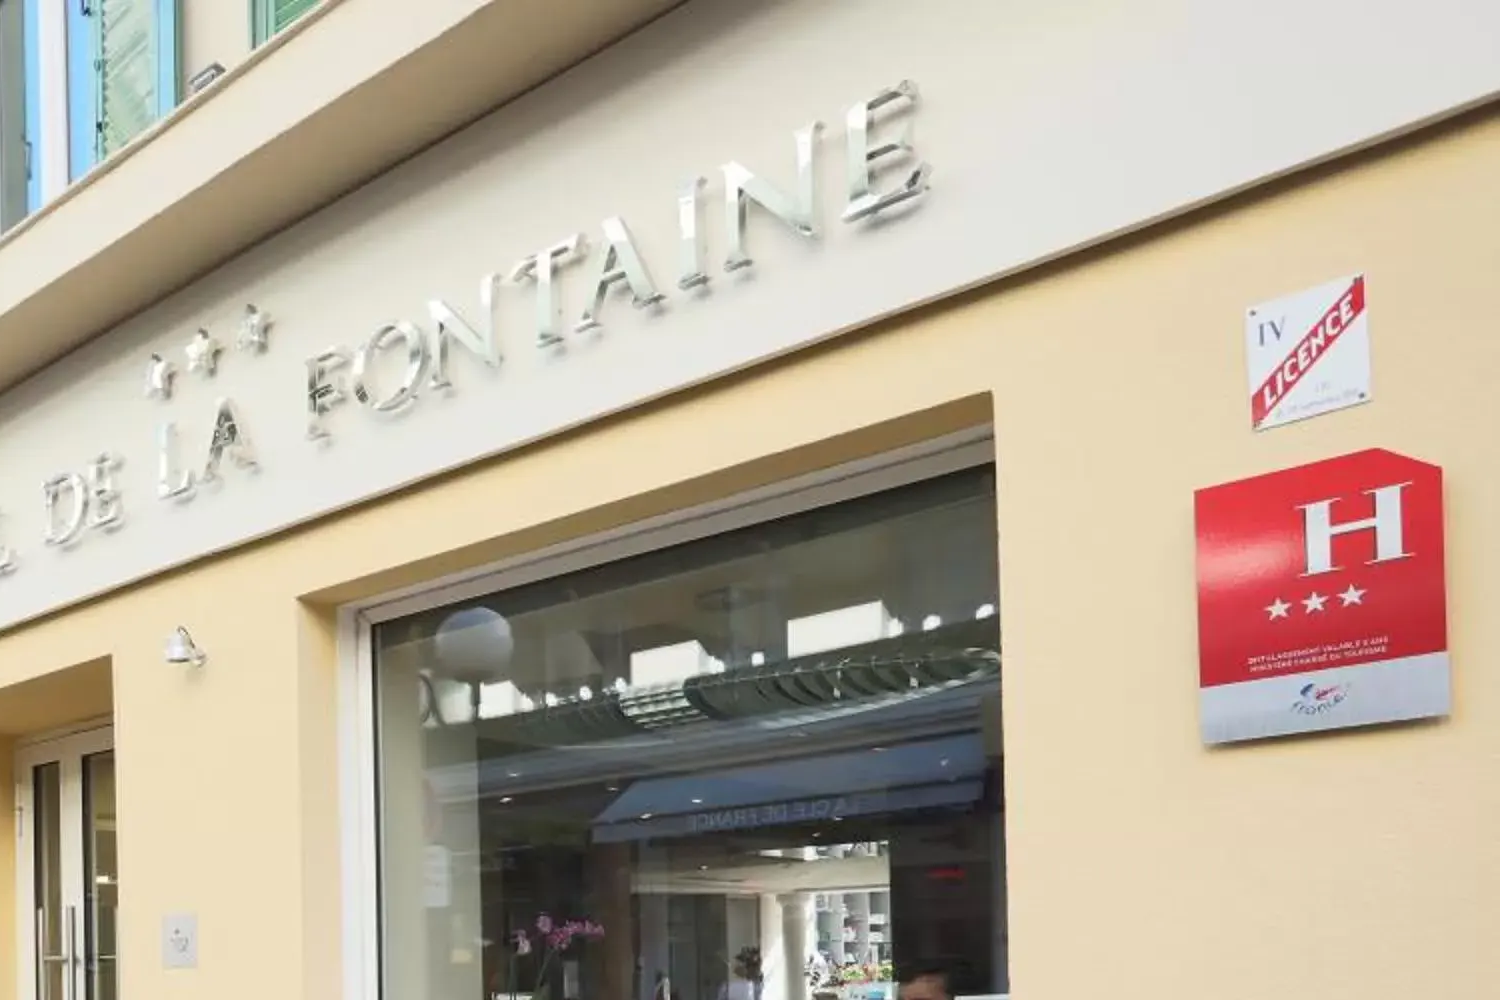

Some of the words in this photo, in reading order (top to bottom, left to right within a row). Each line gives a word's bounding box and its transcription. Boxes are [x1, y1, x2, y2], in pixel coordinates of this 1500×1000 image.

[42, 454, 126, 546] DE
[155, 398, 263, 502] LA
[303, 78, 933, 442] FONTAINE
[1258, 316, 1285, 347] IV
[1263, 292, 1355, 411] LICENCE
[1294, 480, 1416, 577] H
